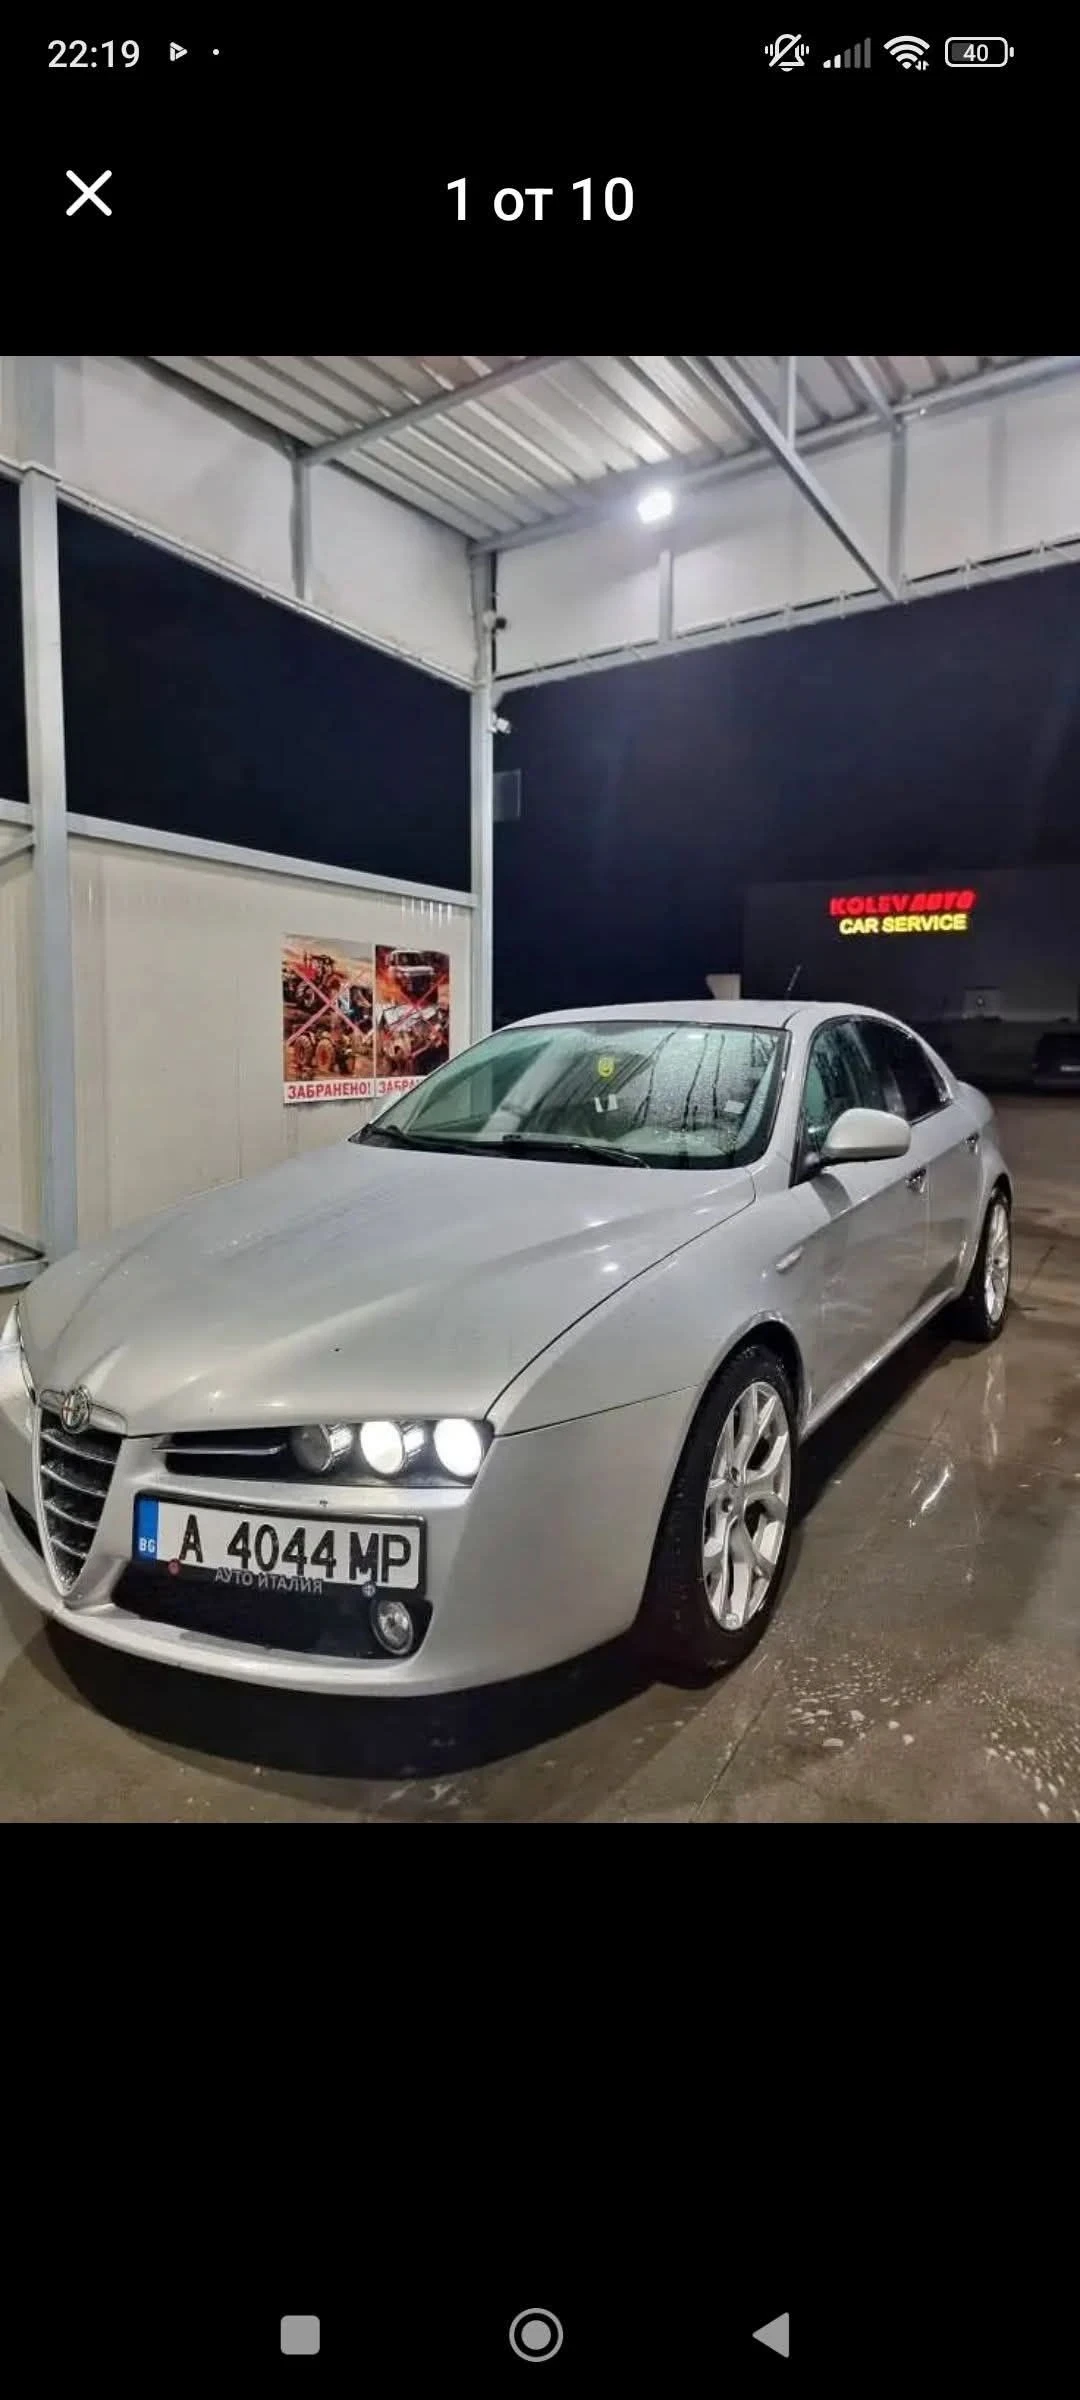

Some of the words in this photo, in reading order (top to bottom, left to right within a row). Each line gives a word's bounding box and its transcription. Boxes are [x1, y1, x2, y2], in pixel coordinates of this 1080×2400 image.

[830, 895, 910, 916] KOLEV
[909, 890, 976, 912] AUTO
[839, 917, 879, 934] CAR
[881, 913, 967, 933] SERVICE
[288, 1081, 371, 1099] ЗАБРАНЕНО!
[138, 1537, 156, 1553] BG
[178, 1514, 203, 1563] A
[227, 1521, 337, 1579] 4044
[257, 1573, 323, 1594] ИТАЛИЯ
